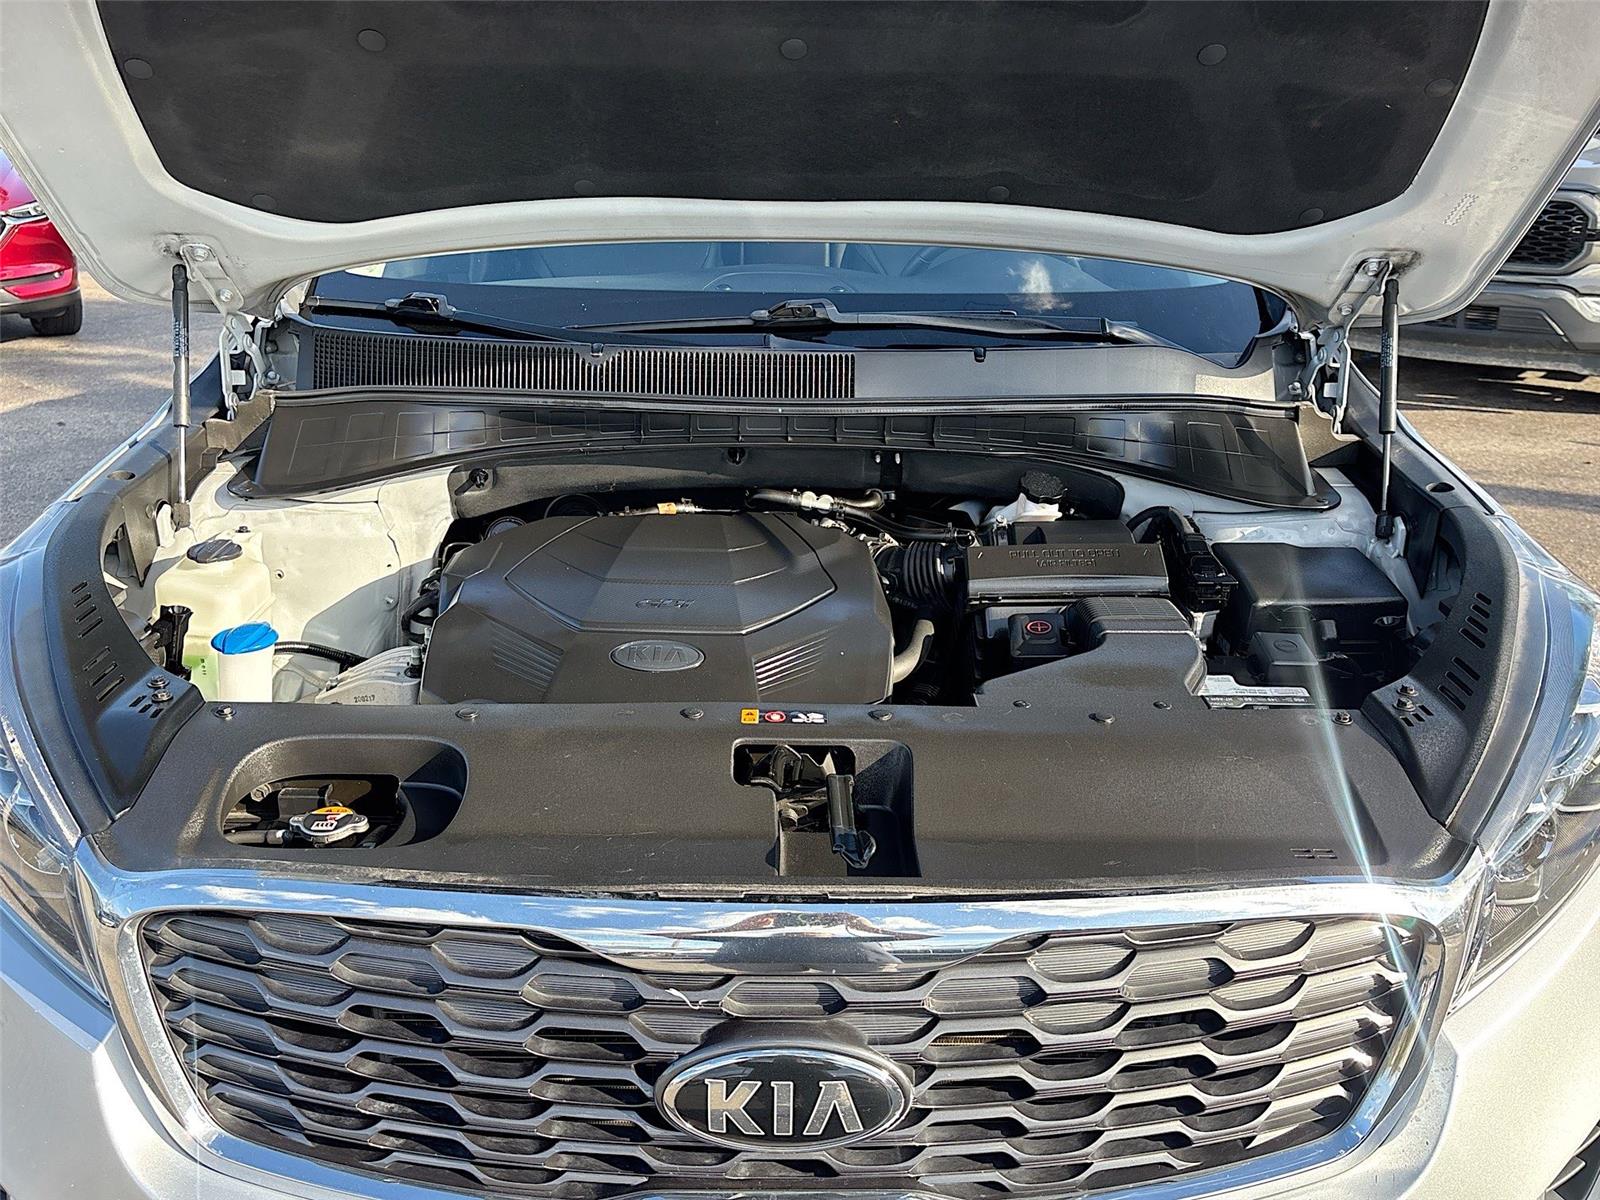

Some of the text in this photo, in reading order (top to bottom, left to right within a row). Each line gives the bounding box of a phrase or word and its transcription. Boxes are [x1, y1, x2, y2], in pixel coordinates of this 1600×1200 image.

[1008, 548, 1121, 559] PULL OUT TO OPEN
[627, 644, 689, 664] KIA
[704, 1078, 864, 1136] KIA
